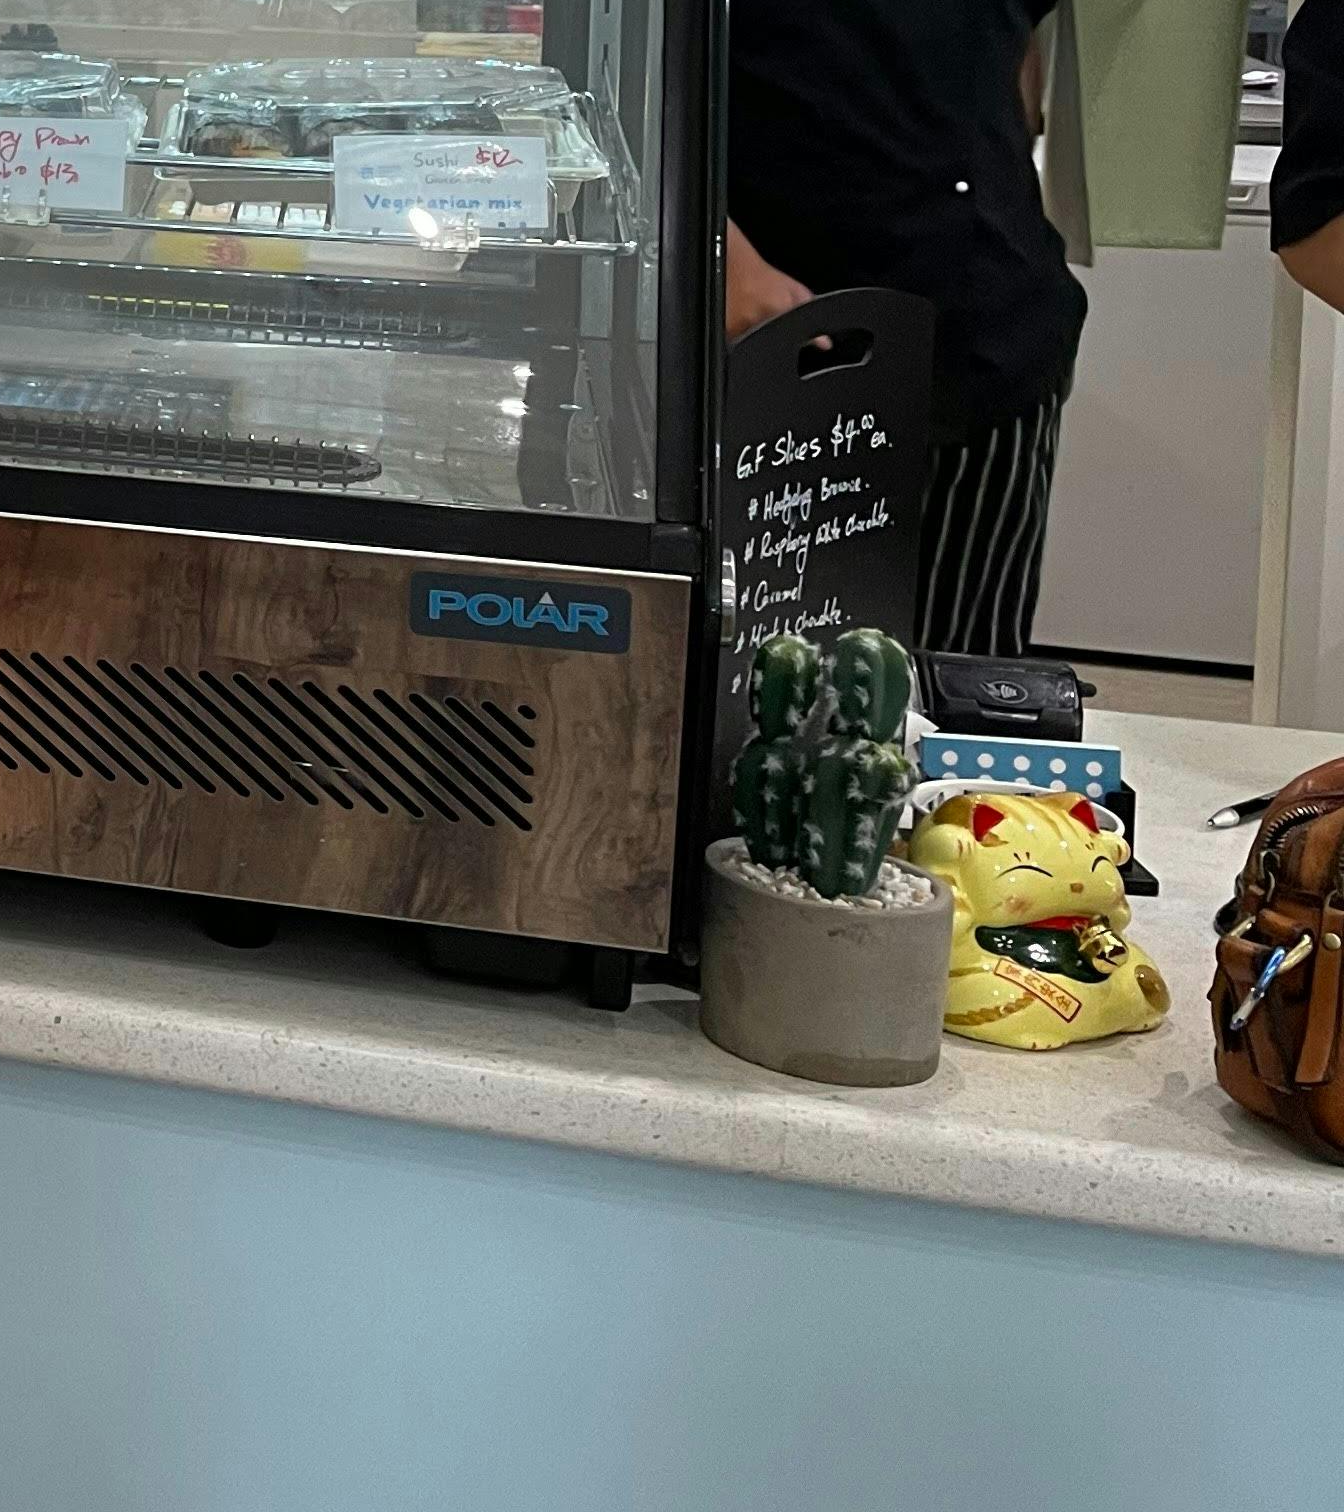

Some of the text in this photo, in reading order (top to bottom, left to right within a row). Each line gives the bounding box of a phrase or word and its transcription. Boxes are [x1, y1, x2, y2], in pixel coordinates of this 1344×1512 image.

[413, 153, 459, 169] Sushi
[488, 195, 523, 210] mix
[771, 430, 822, 466] Slices
[428, 589, 610, 636] POLAR
